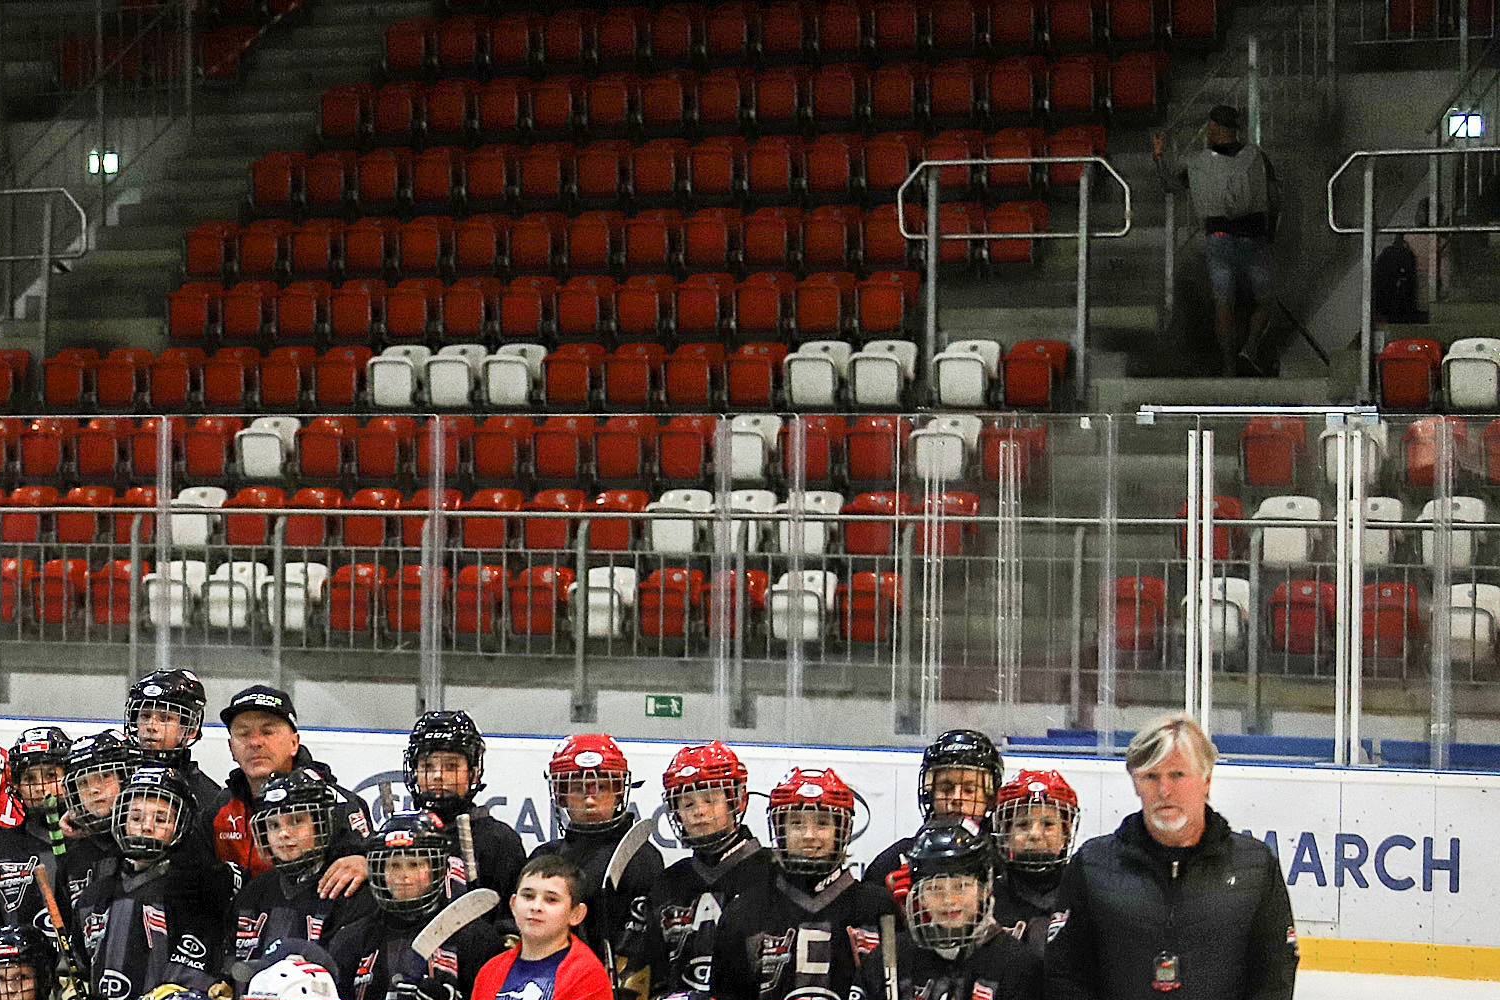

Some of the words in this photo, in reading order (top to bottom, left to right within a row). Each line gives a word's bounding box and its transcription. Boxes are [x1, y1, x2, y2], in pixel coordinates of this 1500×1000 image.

[1241, 829, 1460, 894] ARCH
[692, 892, 723, 931] A
[796, 927, 833, 975] C
